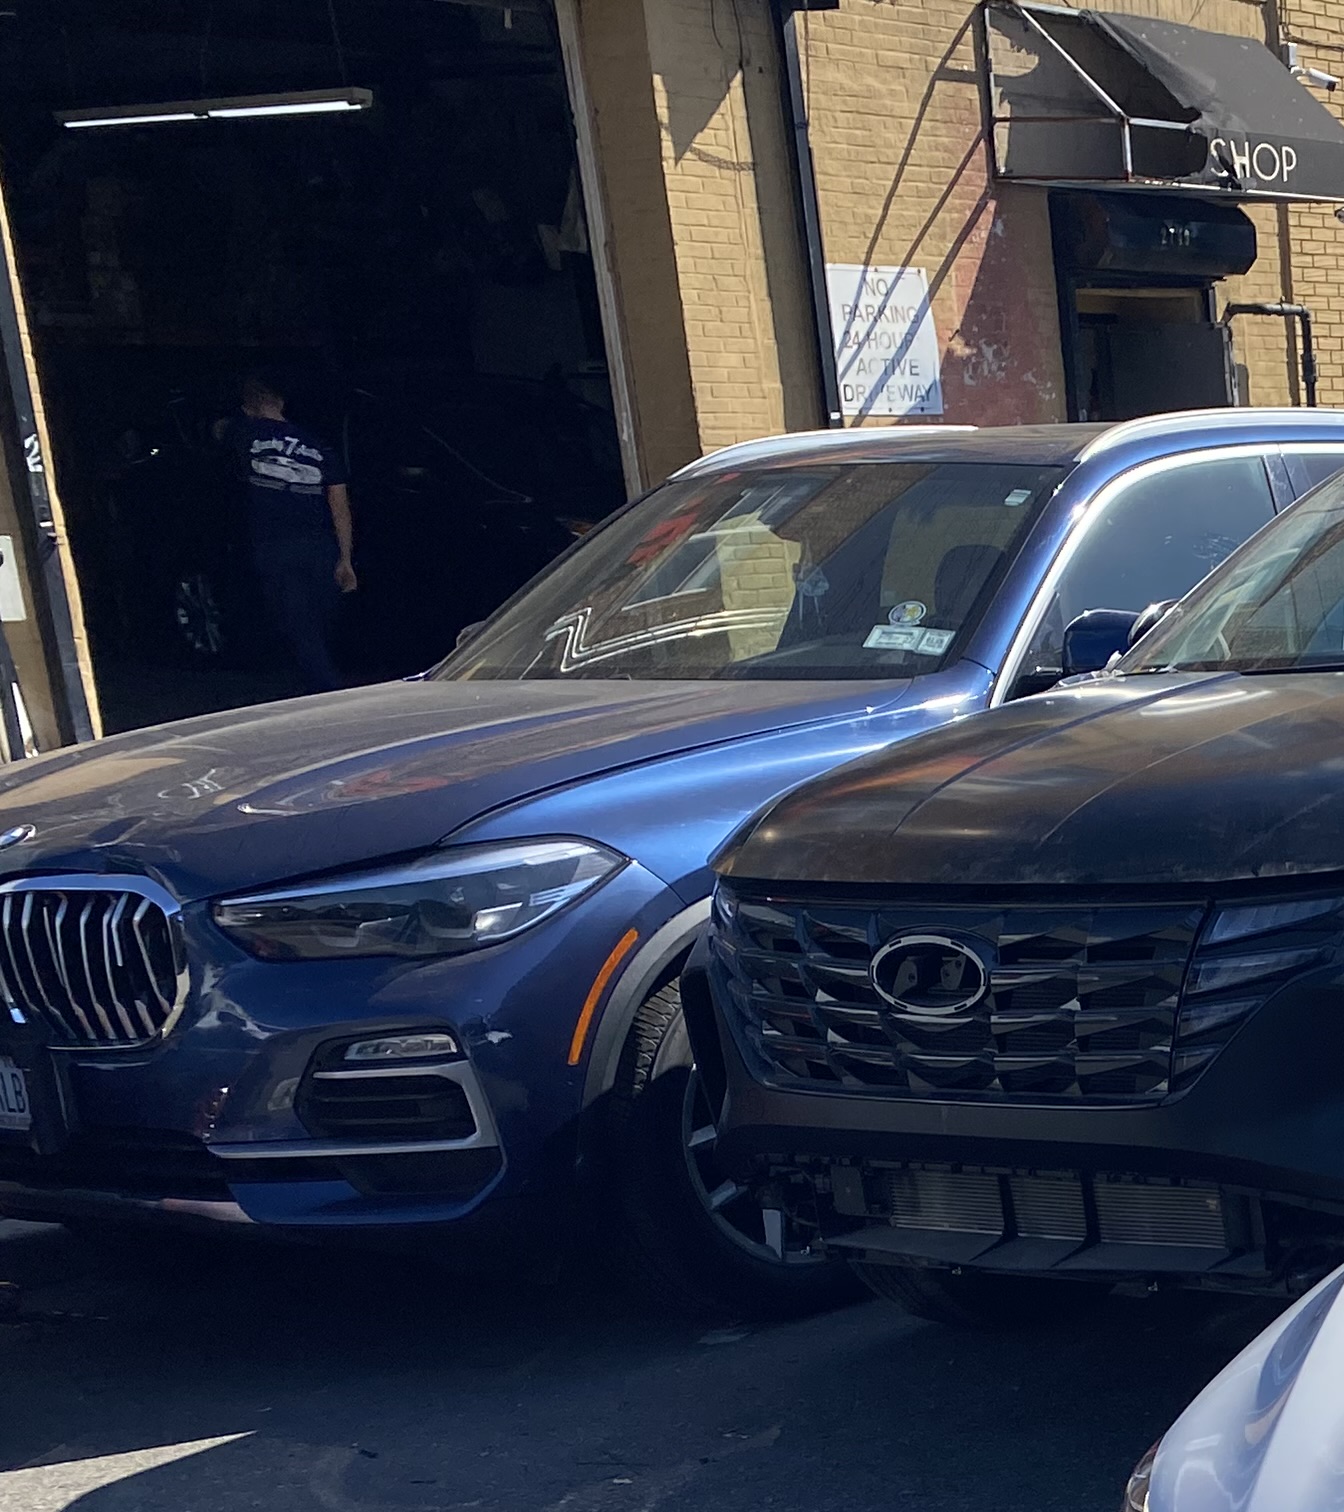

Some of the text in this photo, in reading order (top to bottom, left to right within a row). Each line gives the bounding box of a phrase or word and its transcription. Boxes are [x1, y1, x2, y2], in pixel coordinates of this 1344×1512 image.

[1209, 137, 1298, 183] SHOP
[863, 278, 889, 297] NO
[841, 303, 920, 325] PARKING
[843, 330, 861, 349] 24
[856, 357, 921, 377] ACTIVE
[842, 382, 934, 403] DRIEWAY
[0, 1072, 26, 1113] LB
